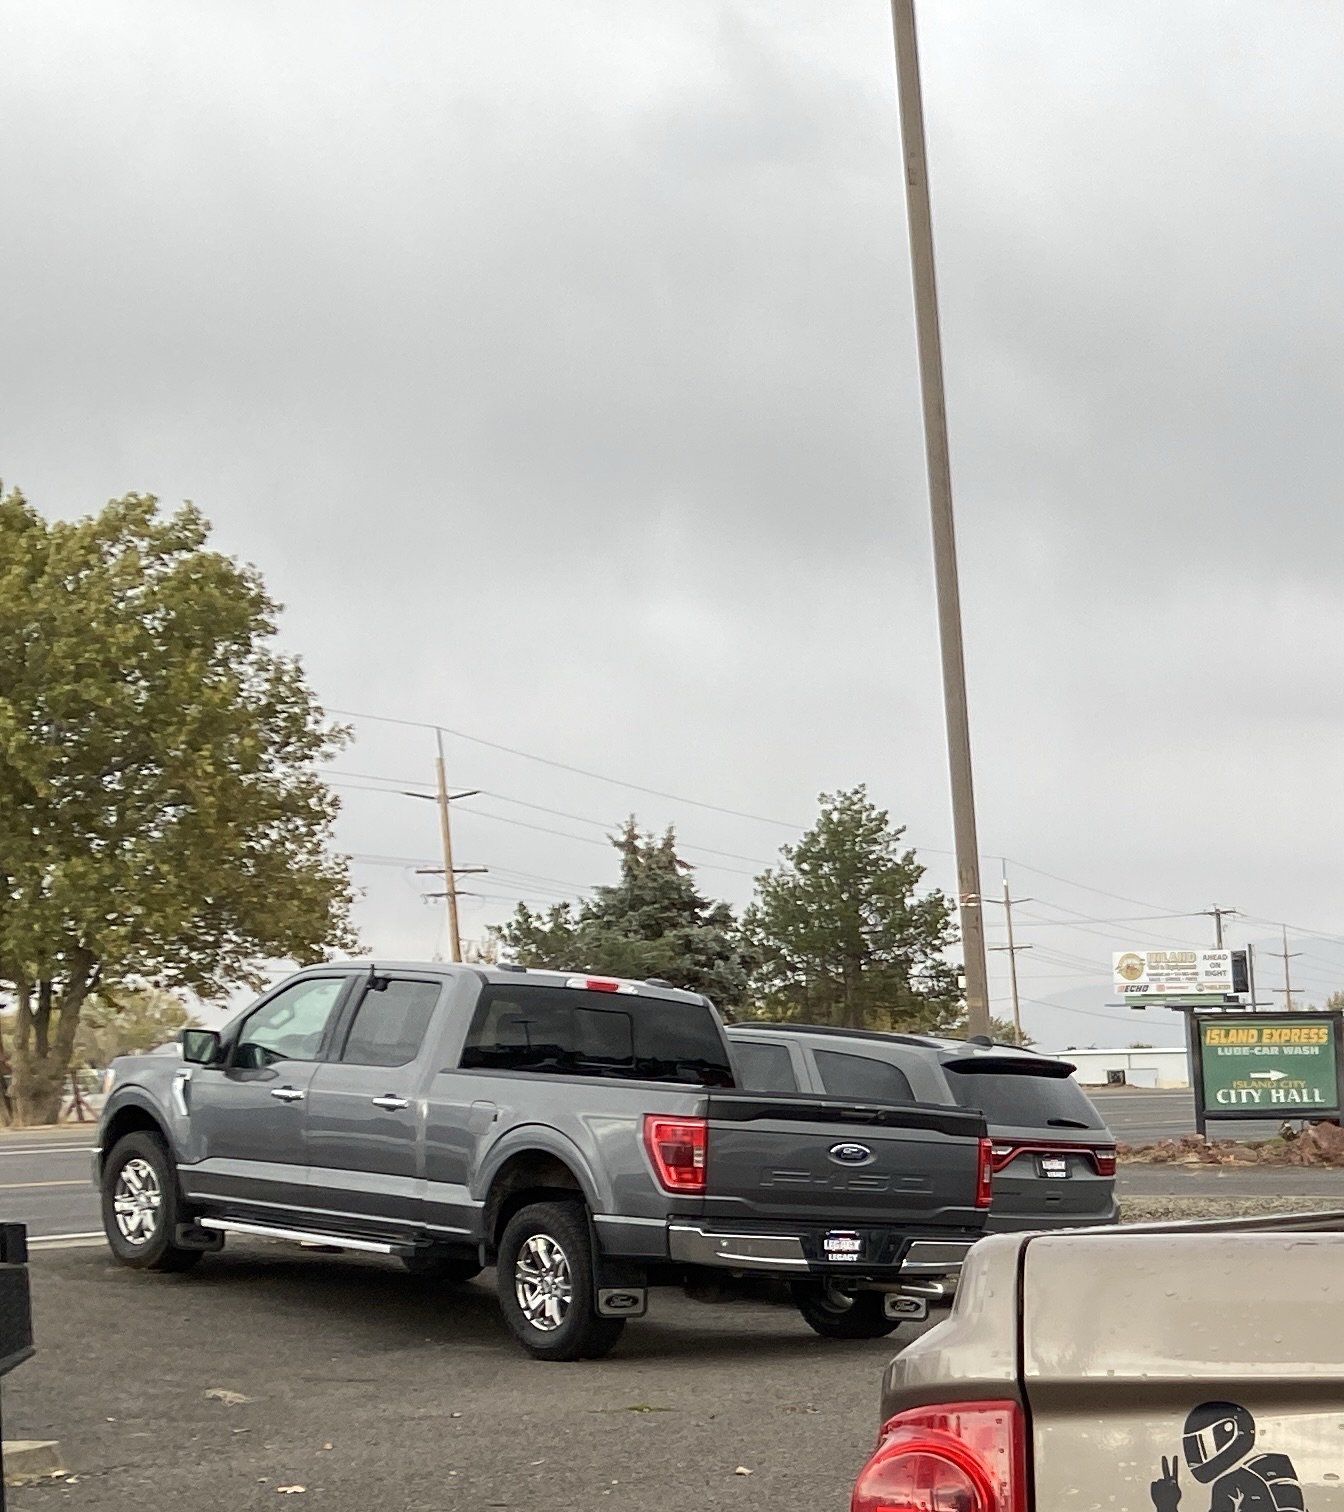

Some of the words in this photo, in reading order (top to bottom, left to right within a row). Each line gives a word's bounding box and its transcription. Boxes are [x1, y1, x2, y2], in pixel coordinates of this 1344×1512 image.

[1206, 1028, 1258, 1044] ISLAND
[1262, 1028, 1328, 1044] EXPRESS
[1282, 1046, 1320, 1055] WASH
[1232, 1080, 1277, 1089] ISLAND
[1279, 1080, 1307, 1088] CITY
[1216, 1089, 1262, 1104] CITY
[1270, 1088, 1326, 1103] HALL
[823, 1239, 861, 1251] LEGACY
[828, 1253, 859, 1261] LEGACY
